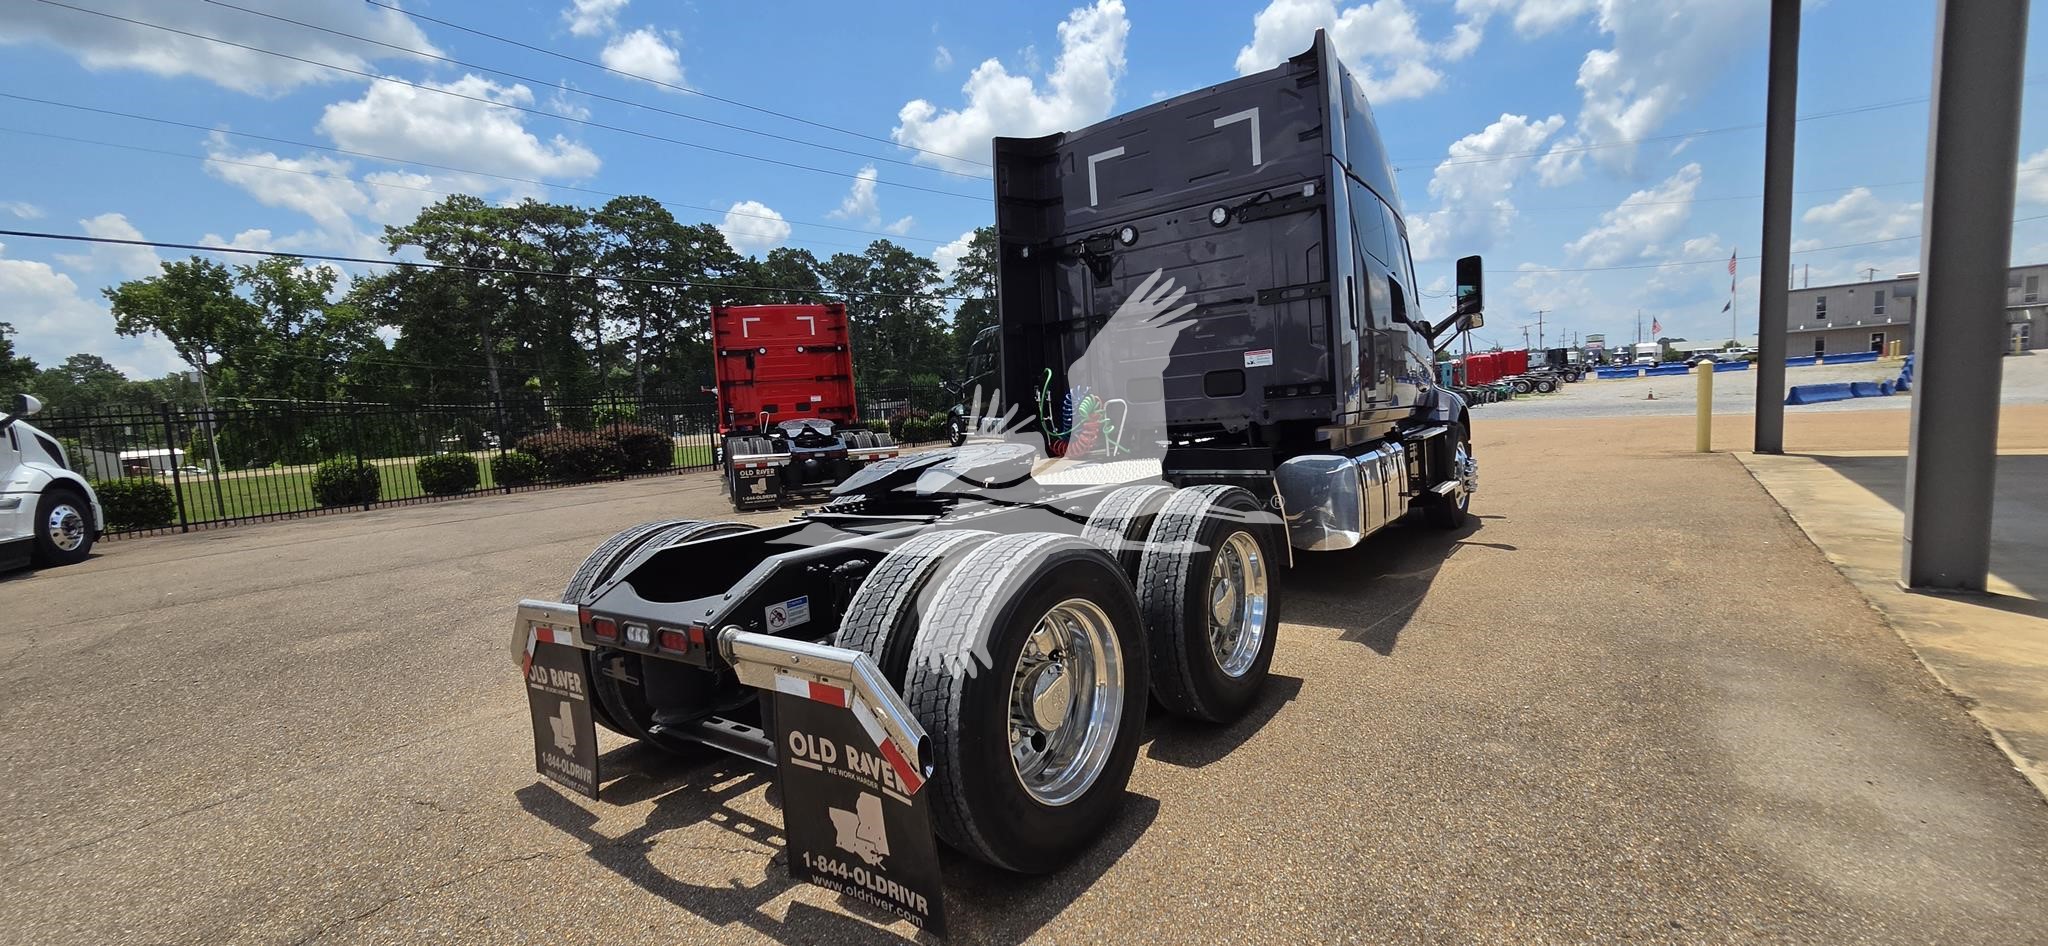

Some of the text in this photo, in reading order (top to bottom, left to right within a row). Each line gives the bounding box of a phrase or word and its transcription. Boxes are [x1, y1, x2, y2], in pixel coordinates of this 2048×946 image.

[549, 668, 583, 693] RIVER
[789, 730, 837, 764] OLD
[542, 751, 592, 784] 1-844-OLDRIVR
[827, 766, 879, 791] WE WORK HARDER
[802, 850, 929, 916] 1-844-OLDRIVR
[811, 873, 924, 928] www.oldriver.com
